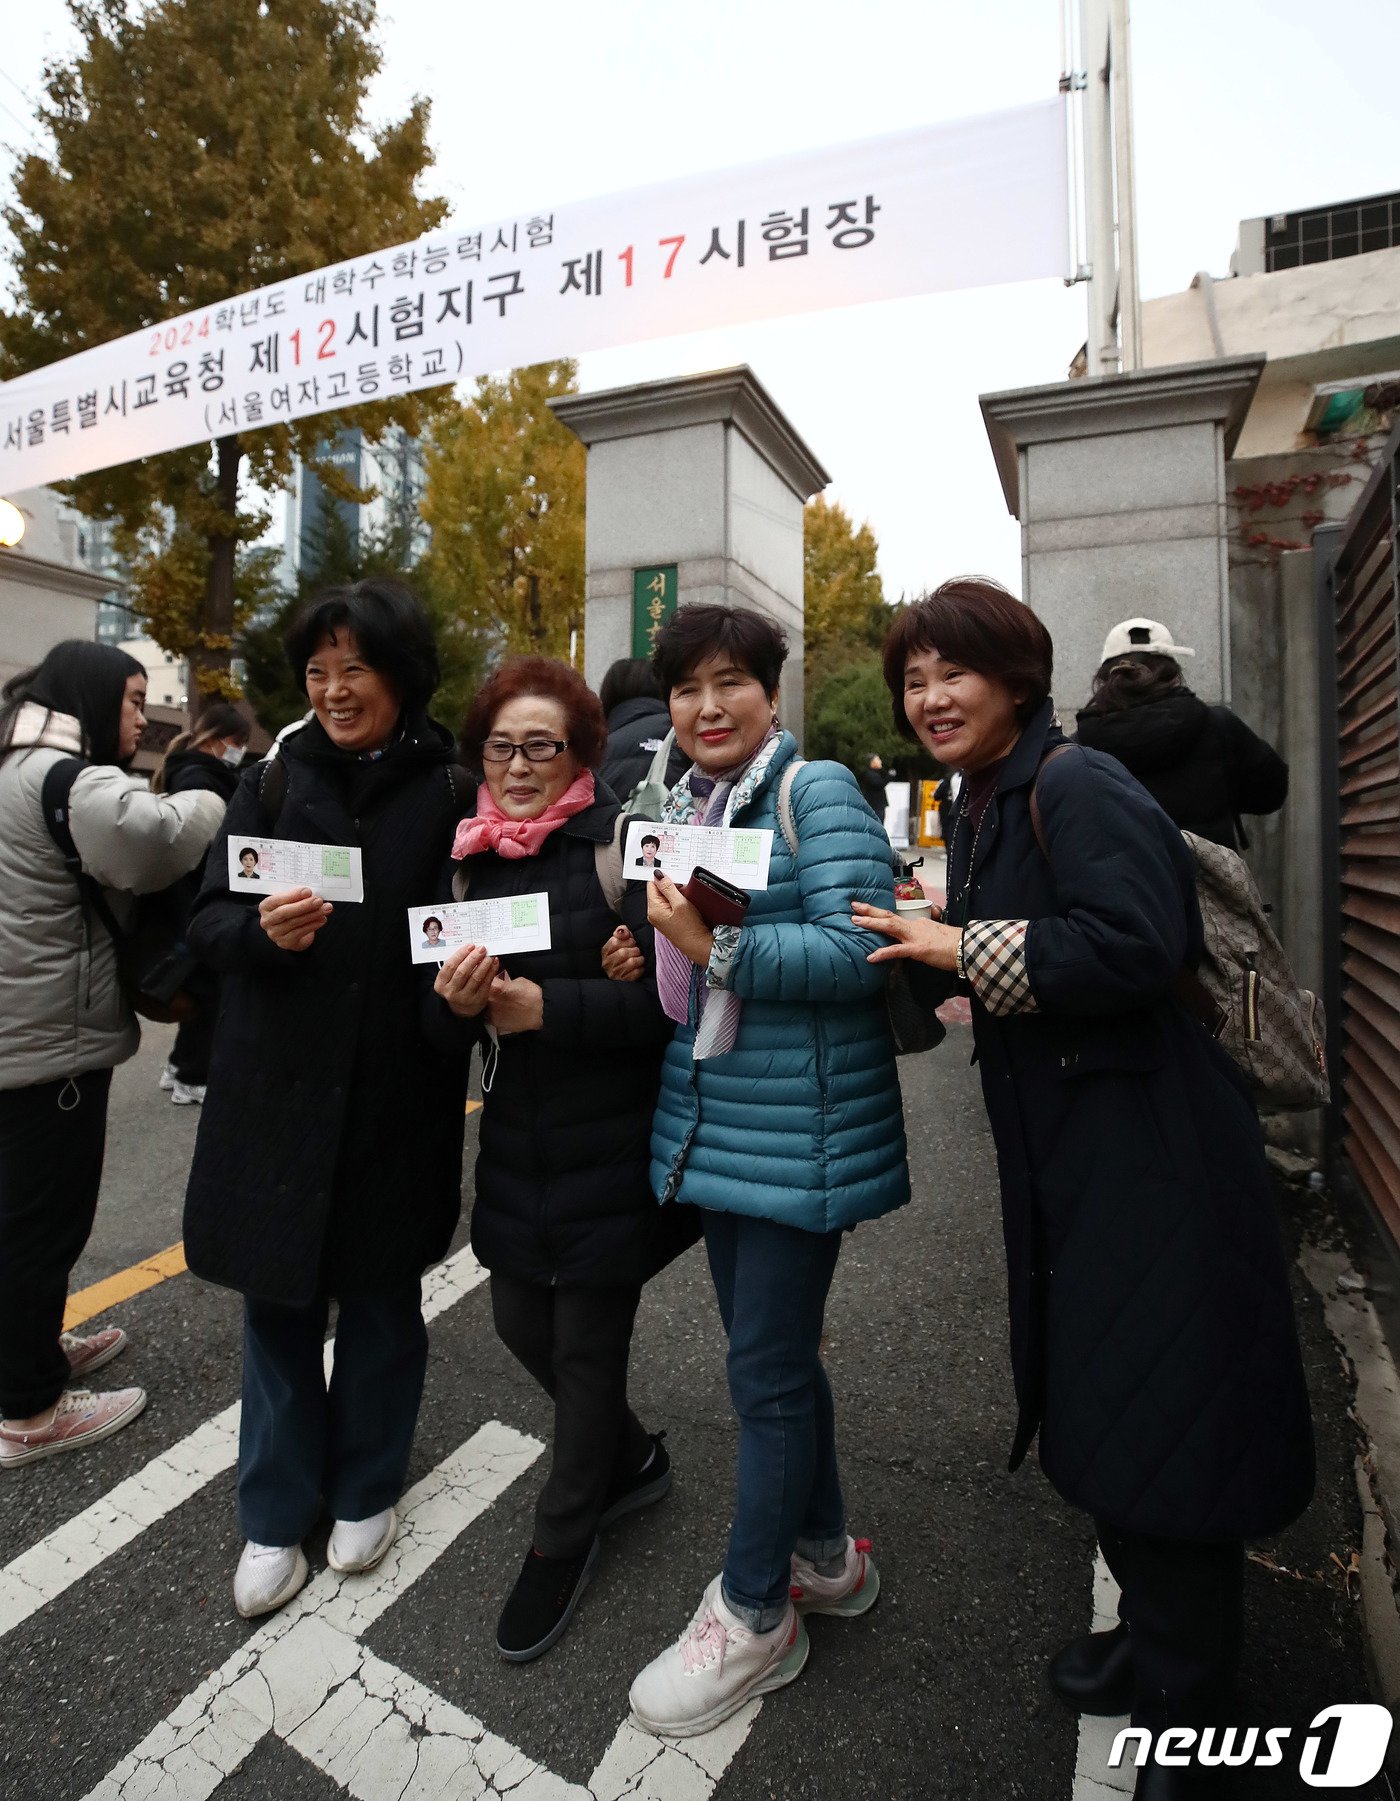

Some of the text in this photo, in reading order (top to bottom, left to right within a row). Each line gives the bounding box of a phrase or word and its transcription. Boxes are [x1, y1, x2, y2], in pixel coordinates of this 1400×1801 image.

[3, 195, 881, 453] 서울특별시교육청 제12시험지구 제17시험장
[149, 213, 555, 357] 2024학년도 대학수학능력시험
[203, 340, 465, 433] (서울여자고등학교)
